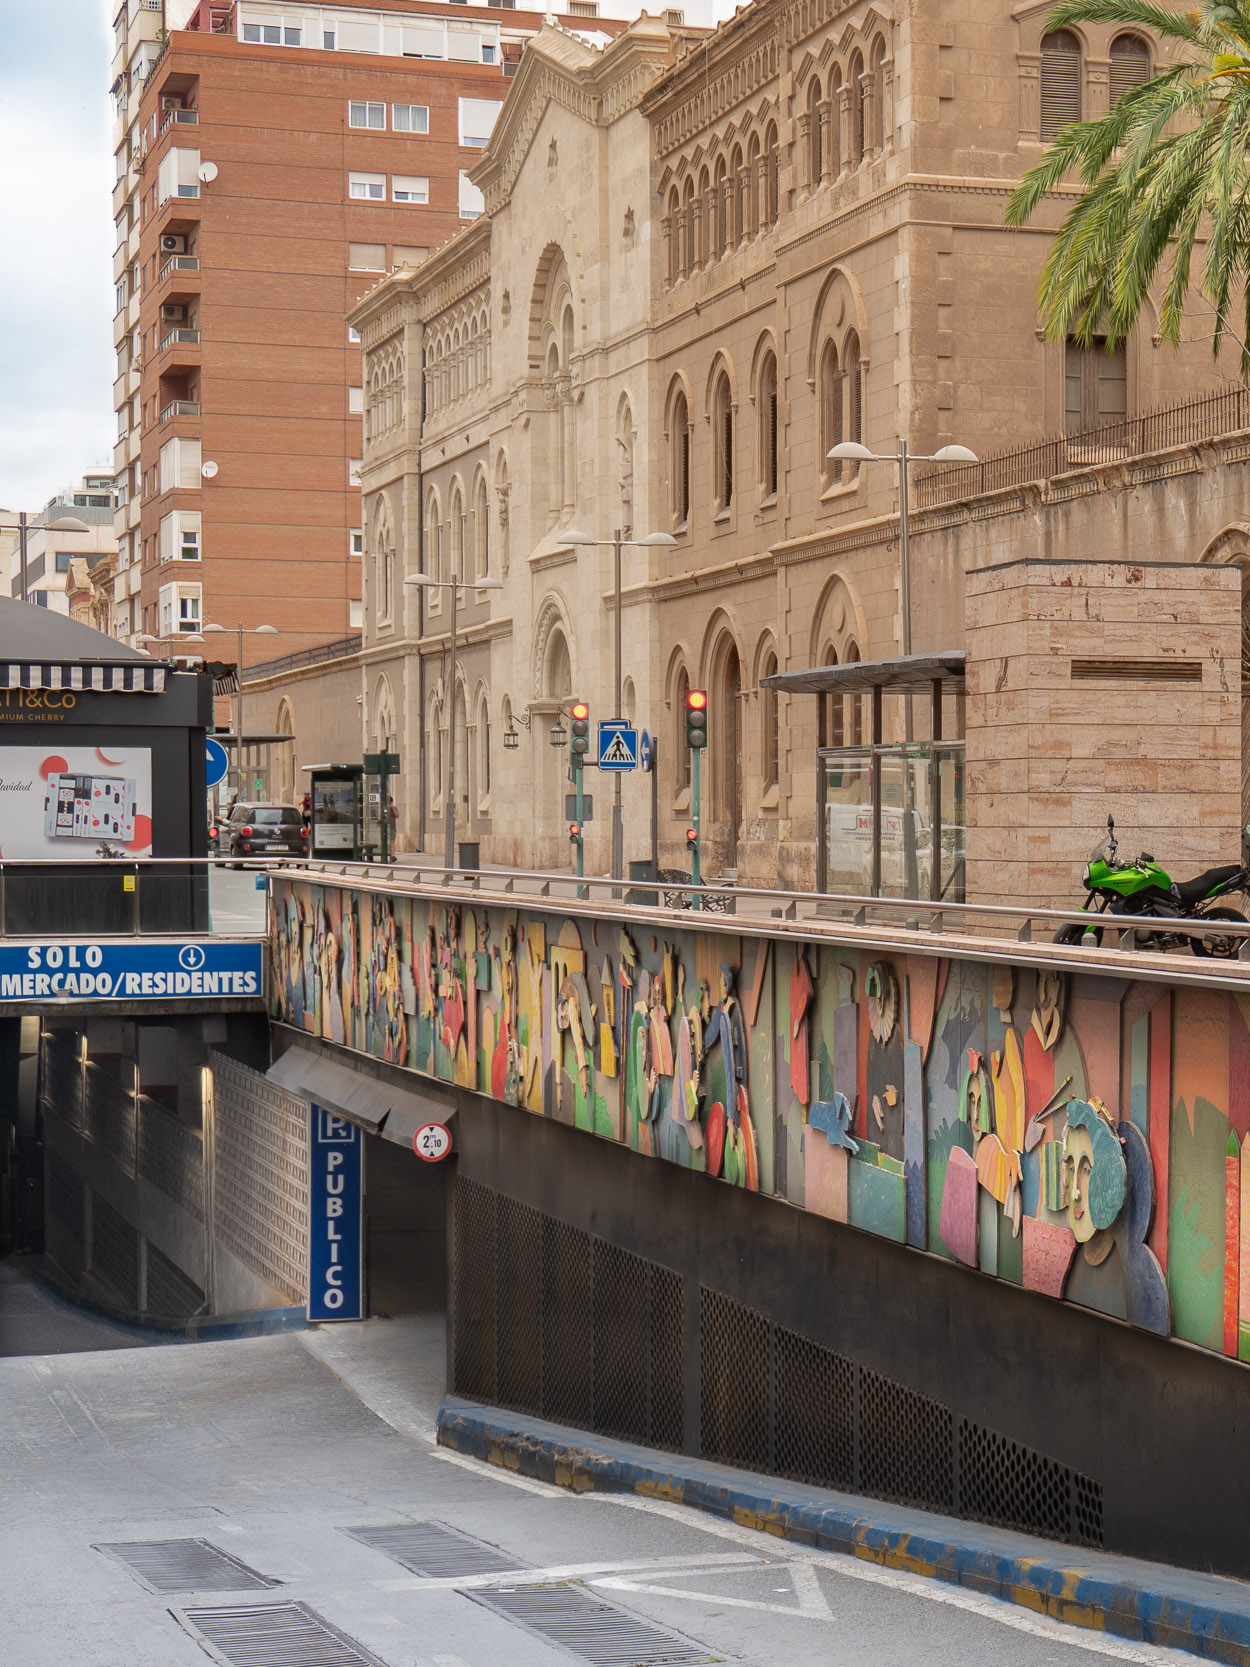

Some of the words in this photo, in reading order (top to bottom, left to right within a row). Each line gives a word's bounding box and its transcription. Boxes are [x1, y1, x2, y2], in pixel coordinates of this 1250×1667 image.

[27, 713, 65, 721] CHERRY
[27, 945, 103, 969] SOLO
[1, 970, 257, 997] MERCADO/RESIDENTES
[323, 1151, 345, 1309] PUBLICO
